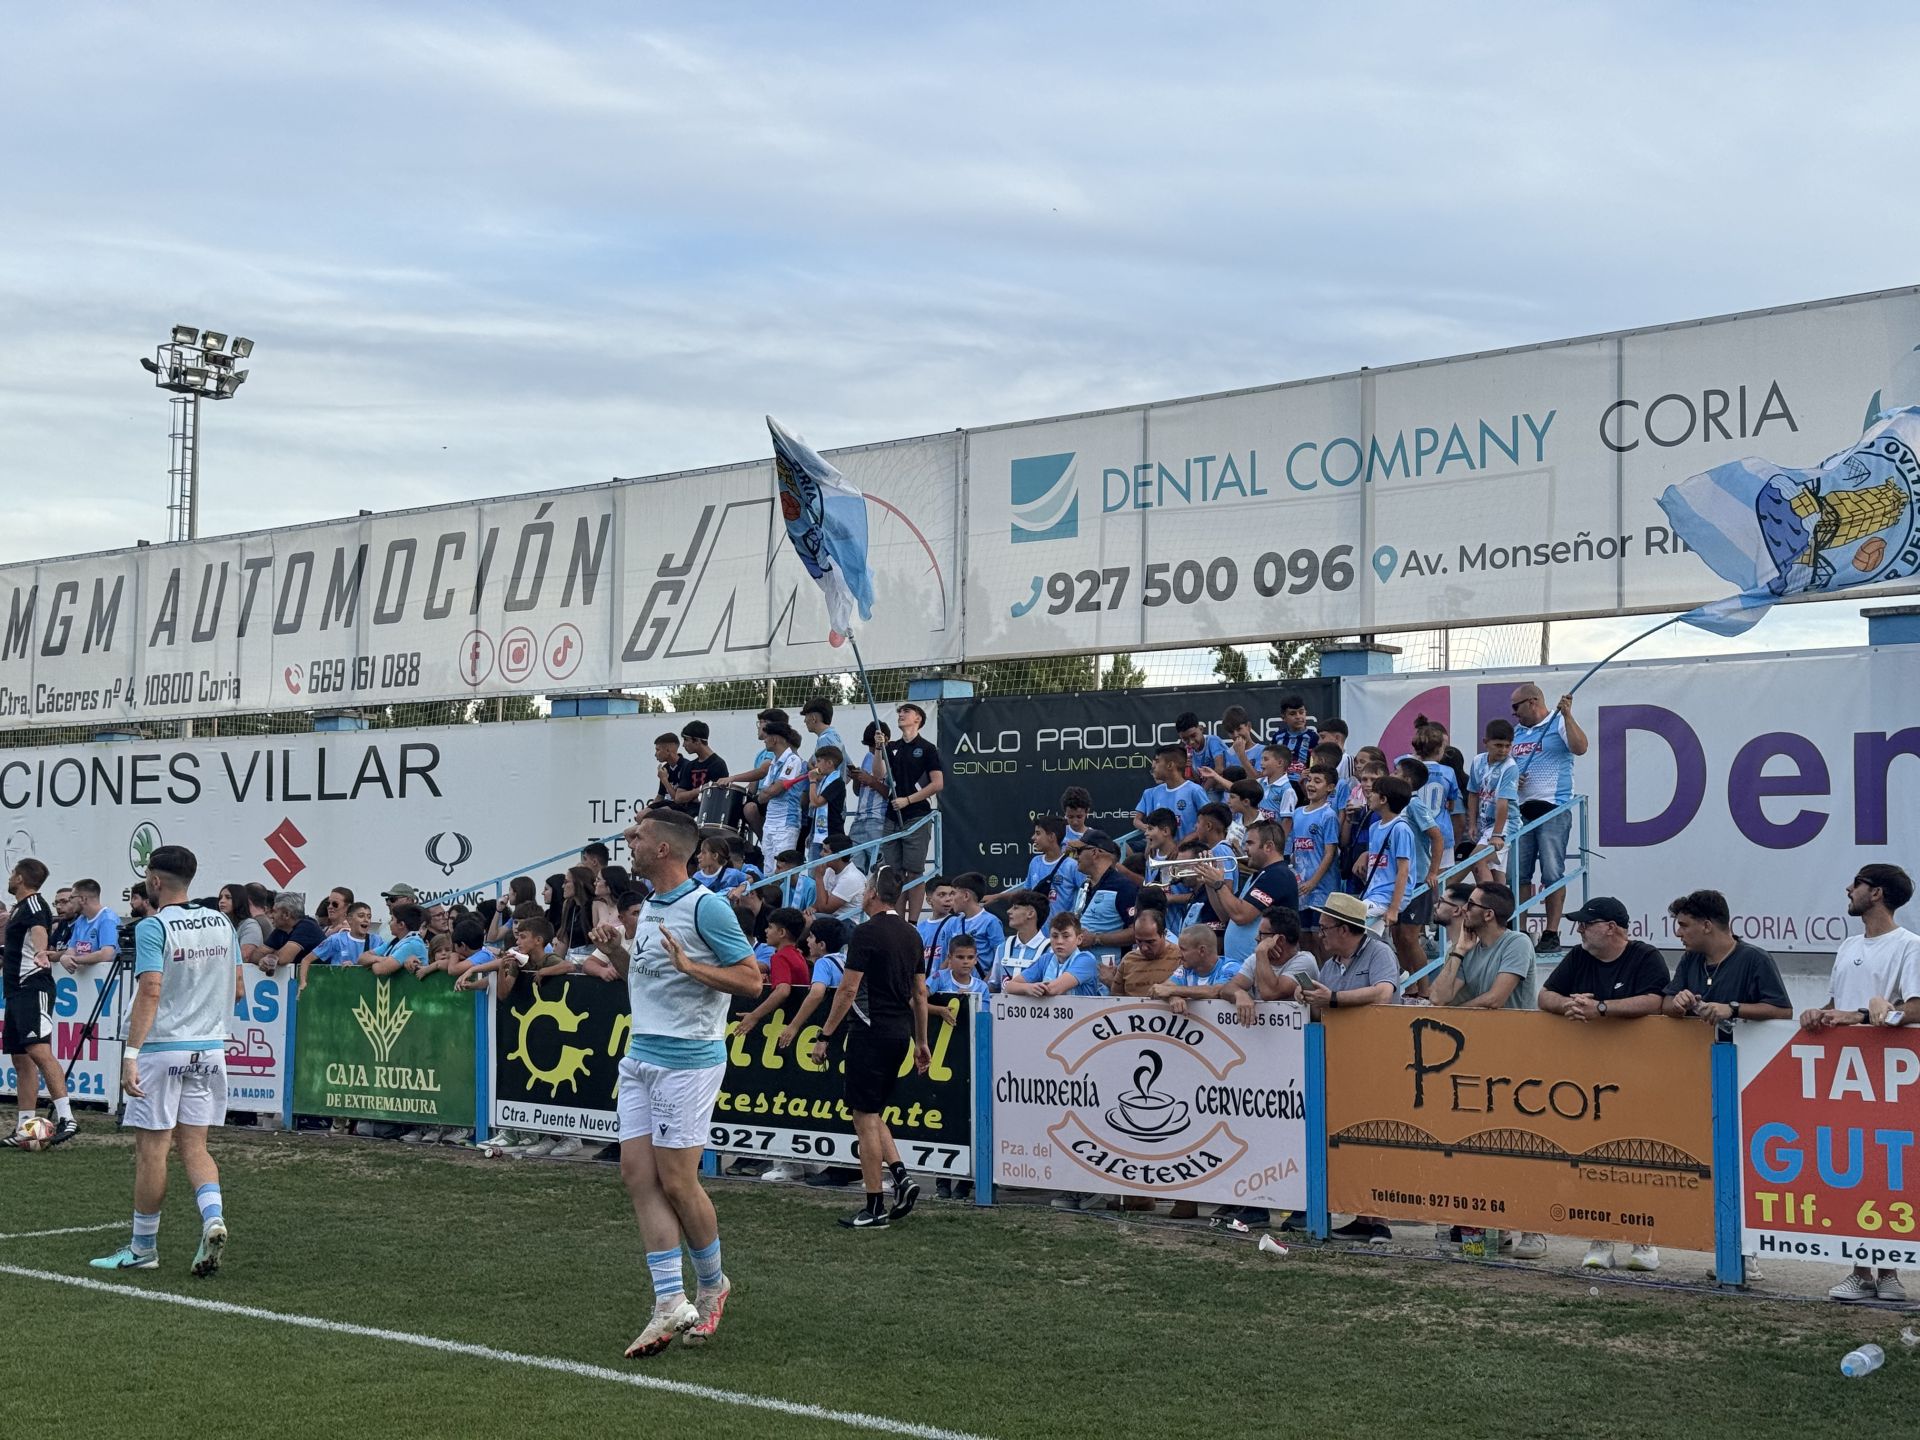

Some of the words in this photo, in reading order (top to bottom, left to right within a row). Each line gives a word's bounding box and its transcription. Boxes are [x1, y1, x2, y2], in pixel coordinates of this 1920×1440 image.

[1103, 449, 1268, 513] DENTAL
[1286, 410, 1557, 491] COMPANY
[1600, 380, 1799, 452] CORIA
[1400, 550, 1448, 578] Av.
[1459, 530, 1634, 573] Monseñor
[2, 574, 125, 661] MGM
[149, 502, 612, 648] AUTOMOCIÓN
[1046, 566, 1131, 616] 927
[1142, 556, 1239, 607] 500
[1253, 545, 1355, 597] 096
[308, 659, 344, 694] 669
[352, 656, 376, 691] 161
[381, 652, 422, 688] 088
[36, 682, 99, 714] Cáceres
[145, 672, 192, 706] 10800
[199, 670, 240, 703] Coria
[954, 730, 1021, 755] ALO
[0, 751, 202, 810] CIONES
[220, 742, 443, 802] VILLAR
[953, 761, 1018, 775] SONIDO
[990, 842, 1019, 854] 617
[169, 915, 227, 932] macron
[1731, 916, 1798, 942] CORIA
[1804, 916, 1849, 944] (CC)
[187, 945, 228, 960] Dentality
[1007, 1005, 1027, 1018] 630
[1030, 1006, 1050, 1019] 024
[1053, 1007, 1074, 1019] 380
[1269, 1013, 1291, 1027] 651
[326, 1063, 368, 1087] CAJA
[375, 1066, 441, 1092] RURAL
[1791, 1044, 1920, 1103] TAP
[242, 1086, 275, 1099] MADRID
[326, 1093, 341, 1108] DE
[344, 1093, 438, 1115] EXTREMADURA
[501, 1105, 530, 1124] Ctra.
[534, 1109, 576, 1129] Puente
[711, 1126, 776, 1151] 927
[791, 1133, 836, 1157] 50
[912, 1145, 961, 1169] 77
[1001, 1140, 1028, 1157] Pza.
[1032, 1141, 1052, 1158] del
[1750, 1122, 1915, 1191] GUT
[1002, 1162, 1041, 1180] Rollo,
[1044, 1166, 1052, 1180] 6
[1234, 1158, 1299, 1197] CORIA
[1578, 1165, 1700, 1190] restaurante
[1371, 1187, 1426, 1207] Teléfono:
[1429, 1193, 1451, 1208] 927
[1454, 1195, 1469, 1210] 50
[1472, 1197, 1487, 1212] 32
[1490, 1198, 1506, 1214] 64
[1755, 1192, 1832, 1228] Tlf.
[1856, 1200, 1916, 1234] 63
[1568, 1206, 1655, 1227] percor_coria
[1759, 1234, 1829, 1257] Hnos.
[1841, 1240, 1917, 1266] López
